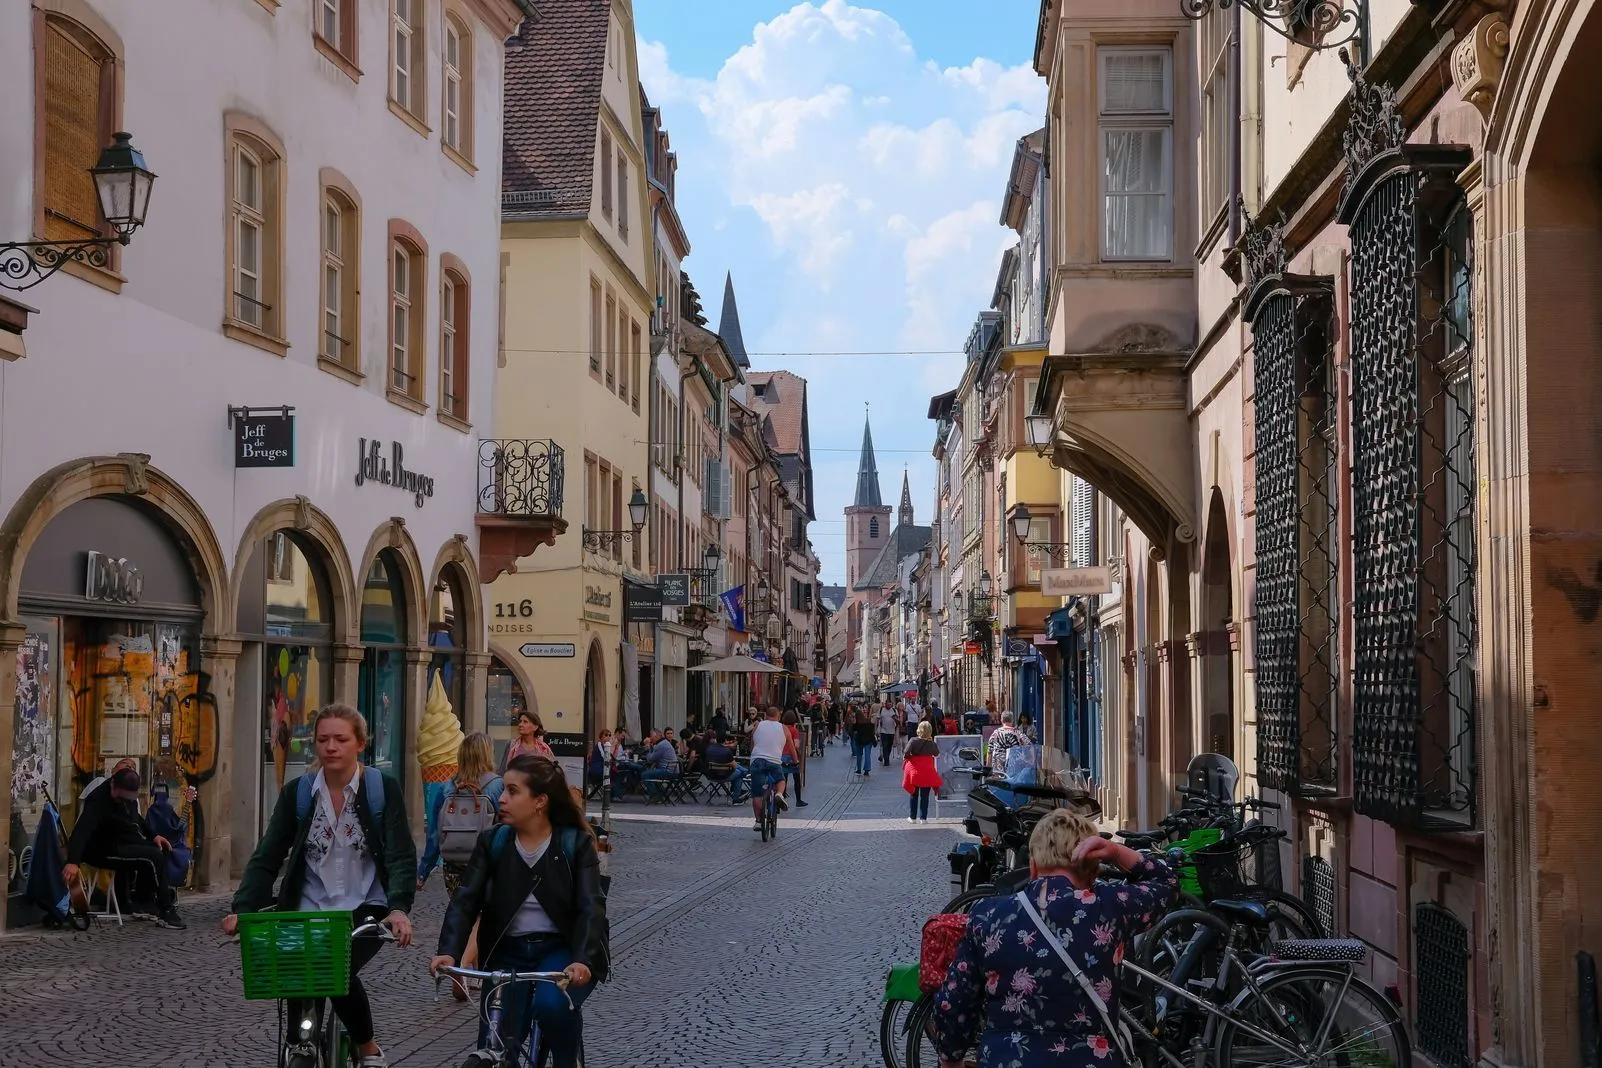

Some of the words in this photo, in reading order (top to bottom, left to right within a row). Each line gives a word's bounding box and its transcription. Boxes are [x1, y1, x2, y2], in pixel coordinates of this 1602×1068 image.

[242, 425, 266, 440] Jeff
[254, 438, 265, 447] de
[242, 444, 288, 461] Bruges
[354, 437, 382, 487] Jeff
[380, 457, 391, 485] de
[391, 440, 434, 508] Bruges
[495, 598, 533, 618] 116
[564, 738, 583, 747] Bruges
